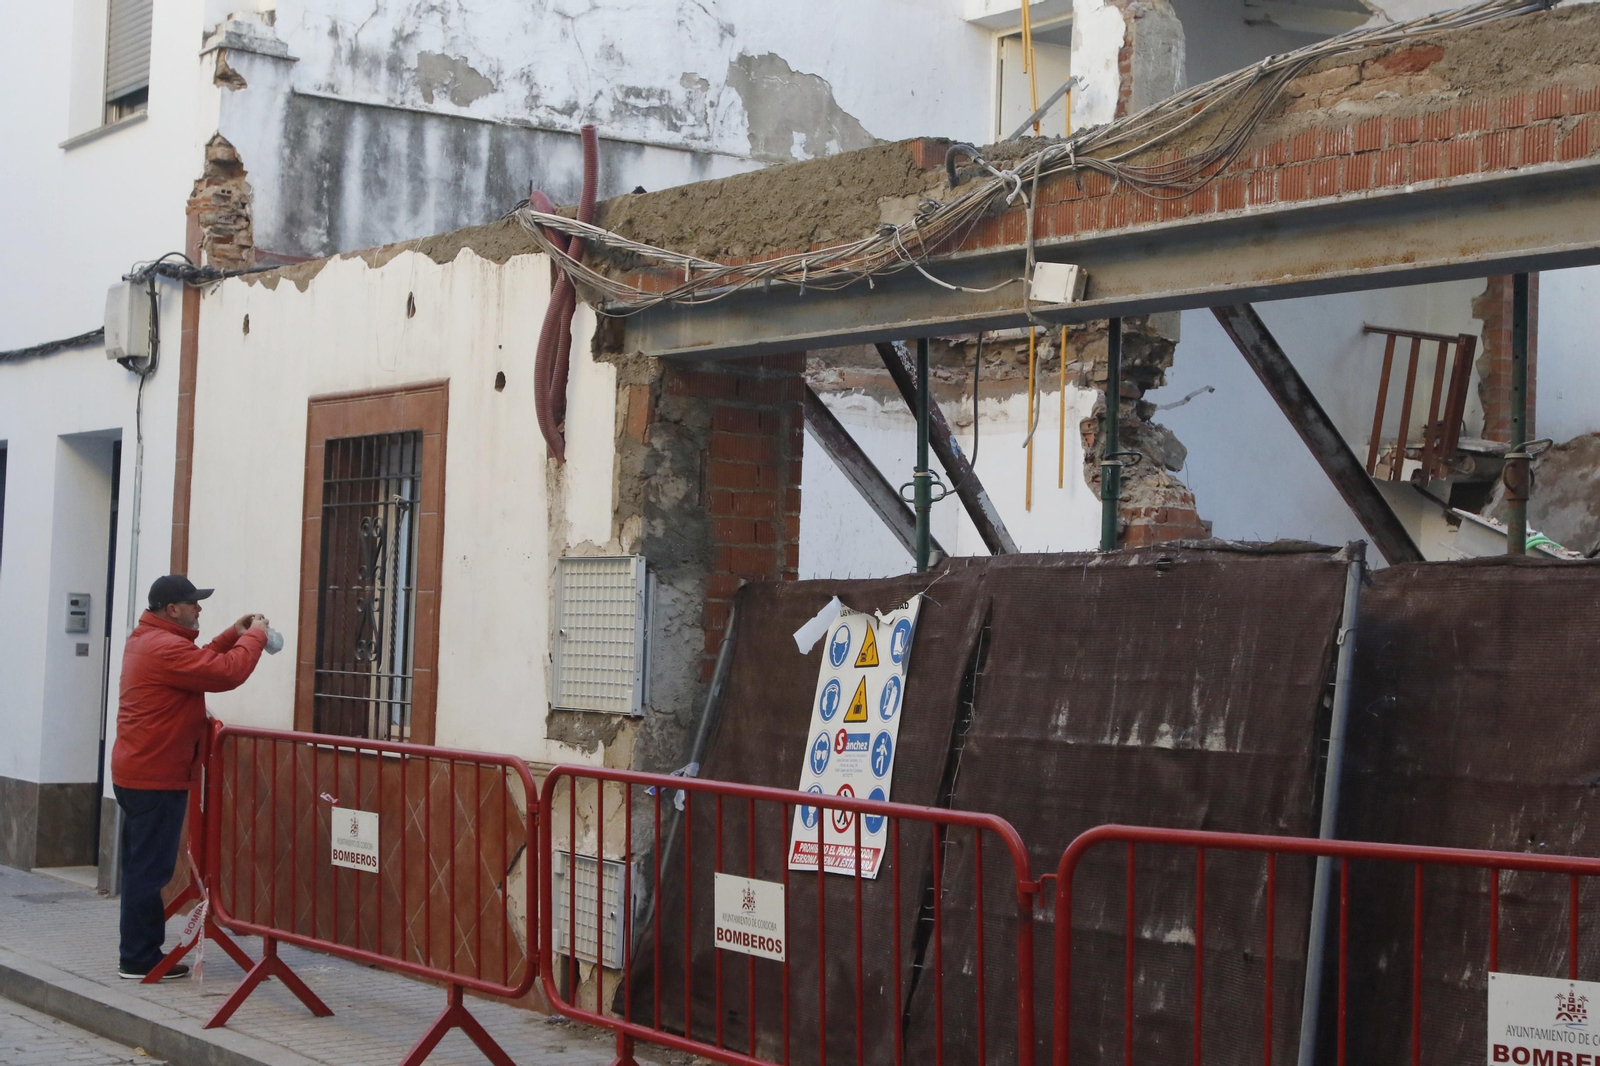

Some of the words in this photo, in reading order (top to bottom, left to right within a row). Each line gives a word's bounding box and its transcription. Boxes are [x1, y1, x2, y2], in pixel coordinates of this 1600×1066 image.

[836, 732, 868, 751] Sánchez
[333, 848, 377, 868] BOMBEROS
[792, 853, 817, 864] PERSONA
[799, 842, 829, 854] PROHIBO
[836, 846, 852, 857] PASO
[717, 926, 783, 954] BOMBEROS
[1506, 1024, 1576, 1044] AYUNTAMIENTO
[1578, 1033, 1590, 1046] DE
[1592, 1034, 1600, 1047] C
[1493, 1043, 1600, 1066] BOMBE
